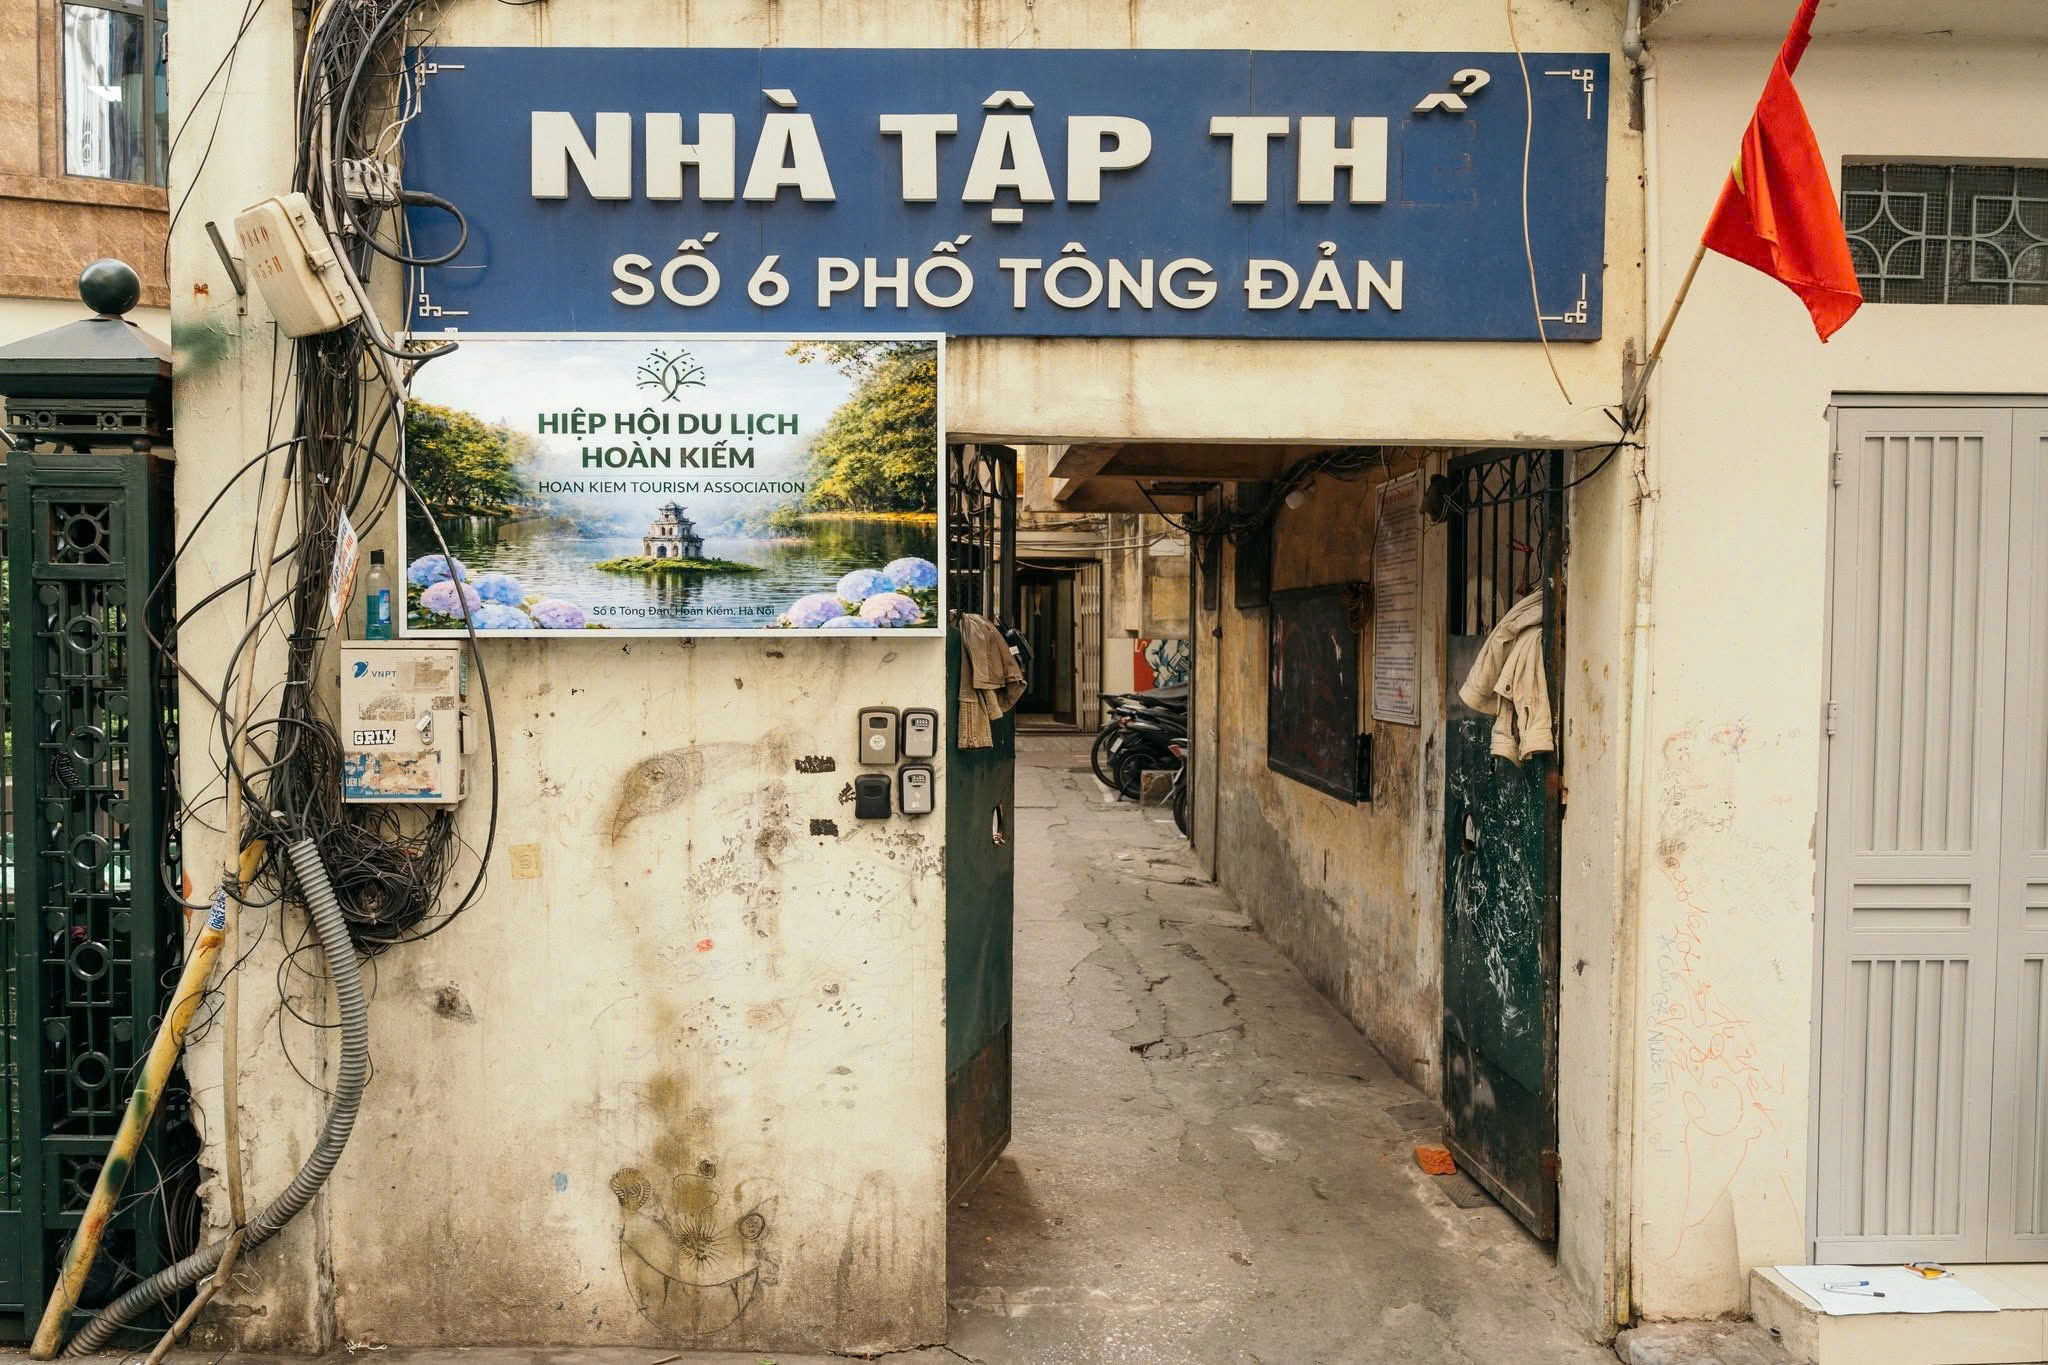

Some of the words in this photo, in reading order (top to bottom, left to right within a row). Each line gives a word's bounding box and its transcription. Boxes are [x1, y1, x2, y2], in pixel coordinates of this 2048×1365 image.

[530, 88, 837, 201] NHÀ
[879, 90, 1152, 225] TẬP
[611, 231, 722, 308] SỐ
[747, 254, 791, 307] 6
[817, 234, 975, 310] PHỐ
[999, 241, 1219, 310] TÔNG
[1243, 240, 1405, 311] ĐẢN
[538, 407, 607, 441] HIỆP
[614, 407, 670, 441] HỘI
[678, 413, 722, 435] DU
[730, 413, 799, 441] LỊCH
[582, 440, 671, 469] HOÀN
[680, 439, 755, 469] KIẾM
[538, 481, 584, 493] HOAN
[589, 481, 626, 493] KIEM
[630, 481, 699, 493] TOURISM
[703, 481, 805, 493] ASSOCIATION
[609, 606, 617, 616] 6
[371, 670, 398, 678] VNPT
[353, 730, 395, 745] GRIM
